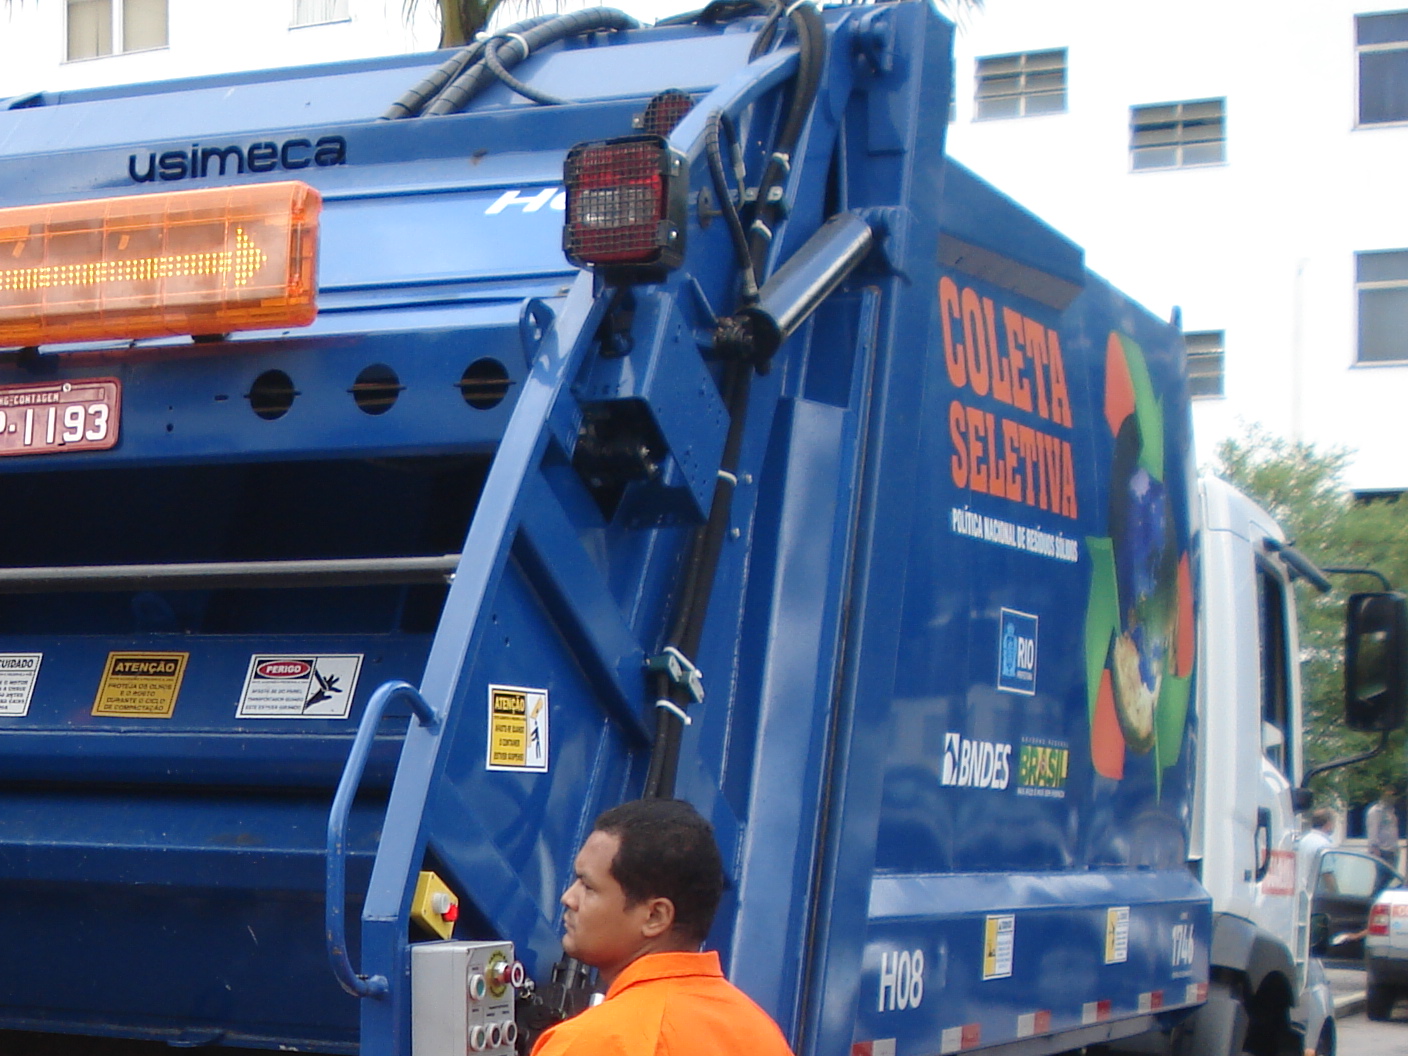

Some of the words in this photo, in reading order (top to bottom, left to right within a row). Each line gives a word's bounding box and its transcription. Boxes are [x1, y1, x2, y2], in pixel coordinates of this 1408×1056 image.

[129, 135, 346, 183] usimeca
[938, 276, 1073, 428] COLETA
[949, 400, 1078, 519] SELETIVA
[115, 661, 175, 674] ATENÇÃO
[266, 665, 302, 673] PERIGO
[1018, 636, 1035, 670] RIO
[495, 696, 525, 714] ATENÇÃO
[958, 739, 1012, 790] BNDES
[1019, 745, 1069, 787] BRASIL
[878, 949, 924, 1012] H08
